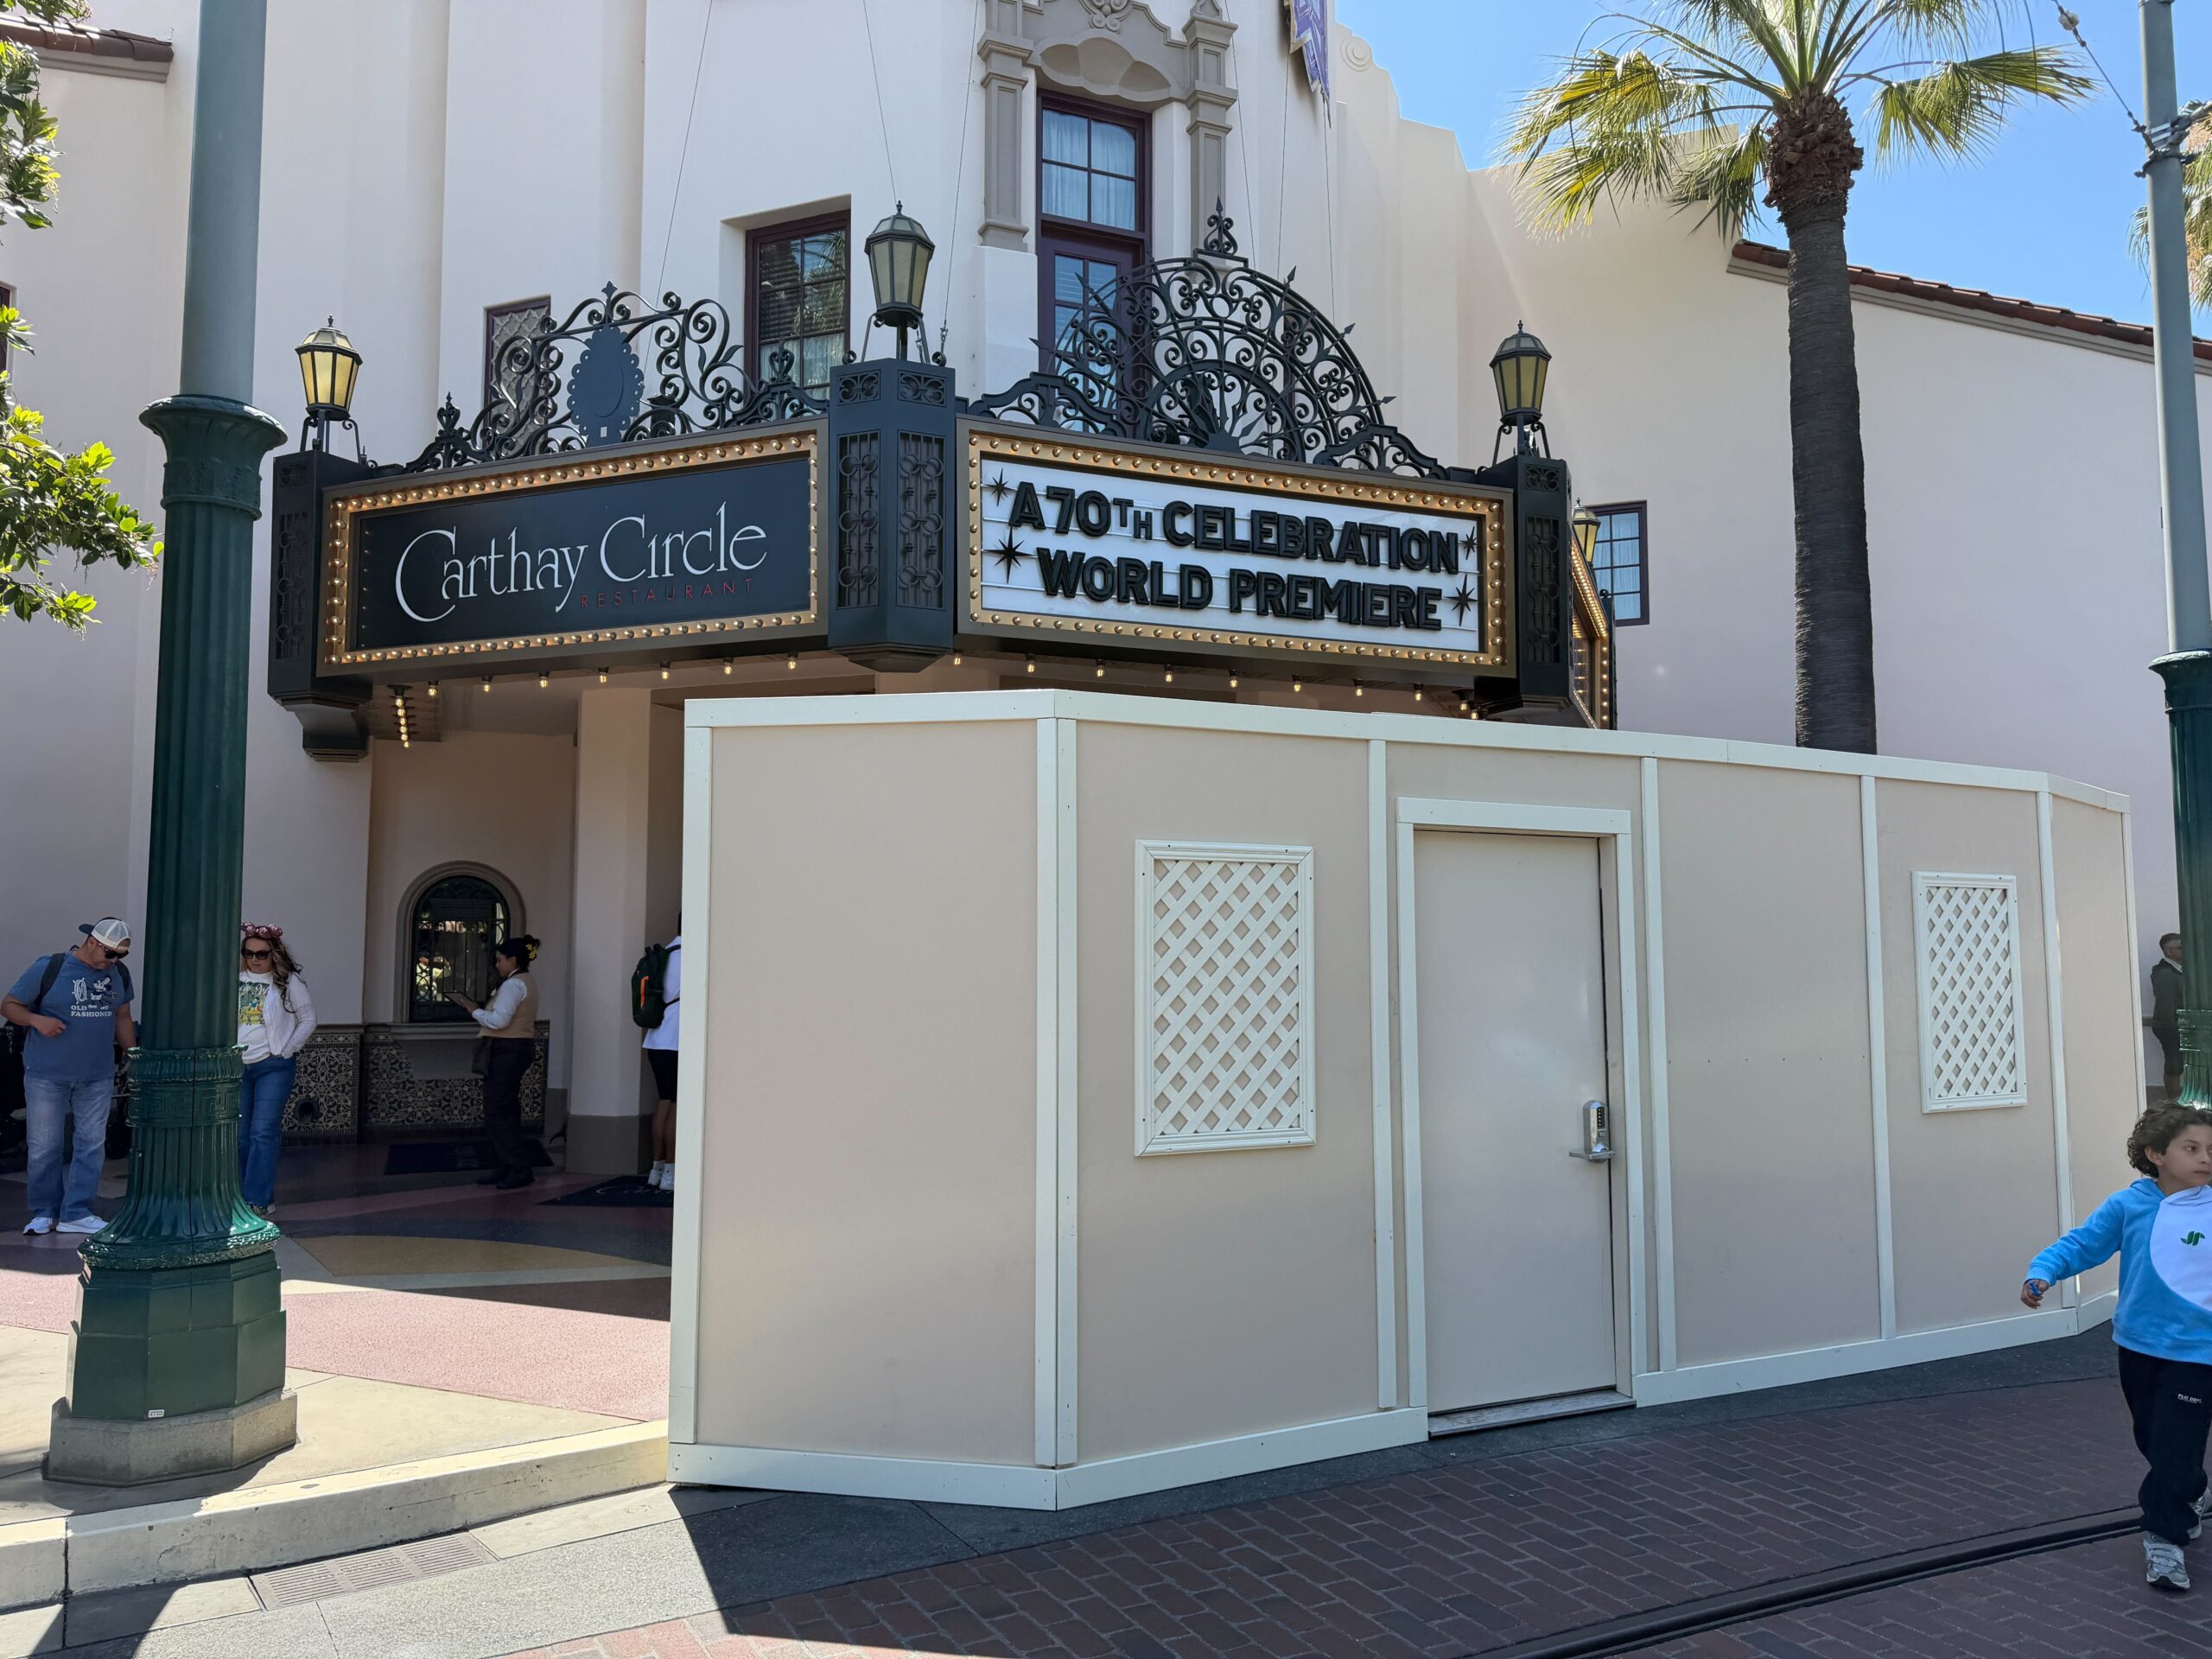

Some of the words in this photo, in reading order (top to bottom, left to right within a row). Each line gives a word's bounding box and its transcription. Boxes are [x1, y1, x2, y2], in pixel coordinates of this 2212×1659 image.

[395, 525, 588, 622] Carthay
[600, 501, 767, 582] Circle
[1162, 500, 1459, 575] CELEBRATION
[582, 578, 753, 607] RESTAURANT
[1036, 546, 1213, 612] WORLD
[1229, 567, 1442, 631] PREMIERE
